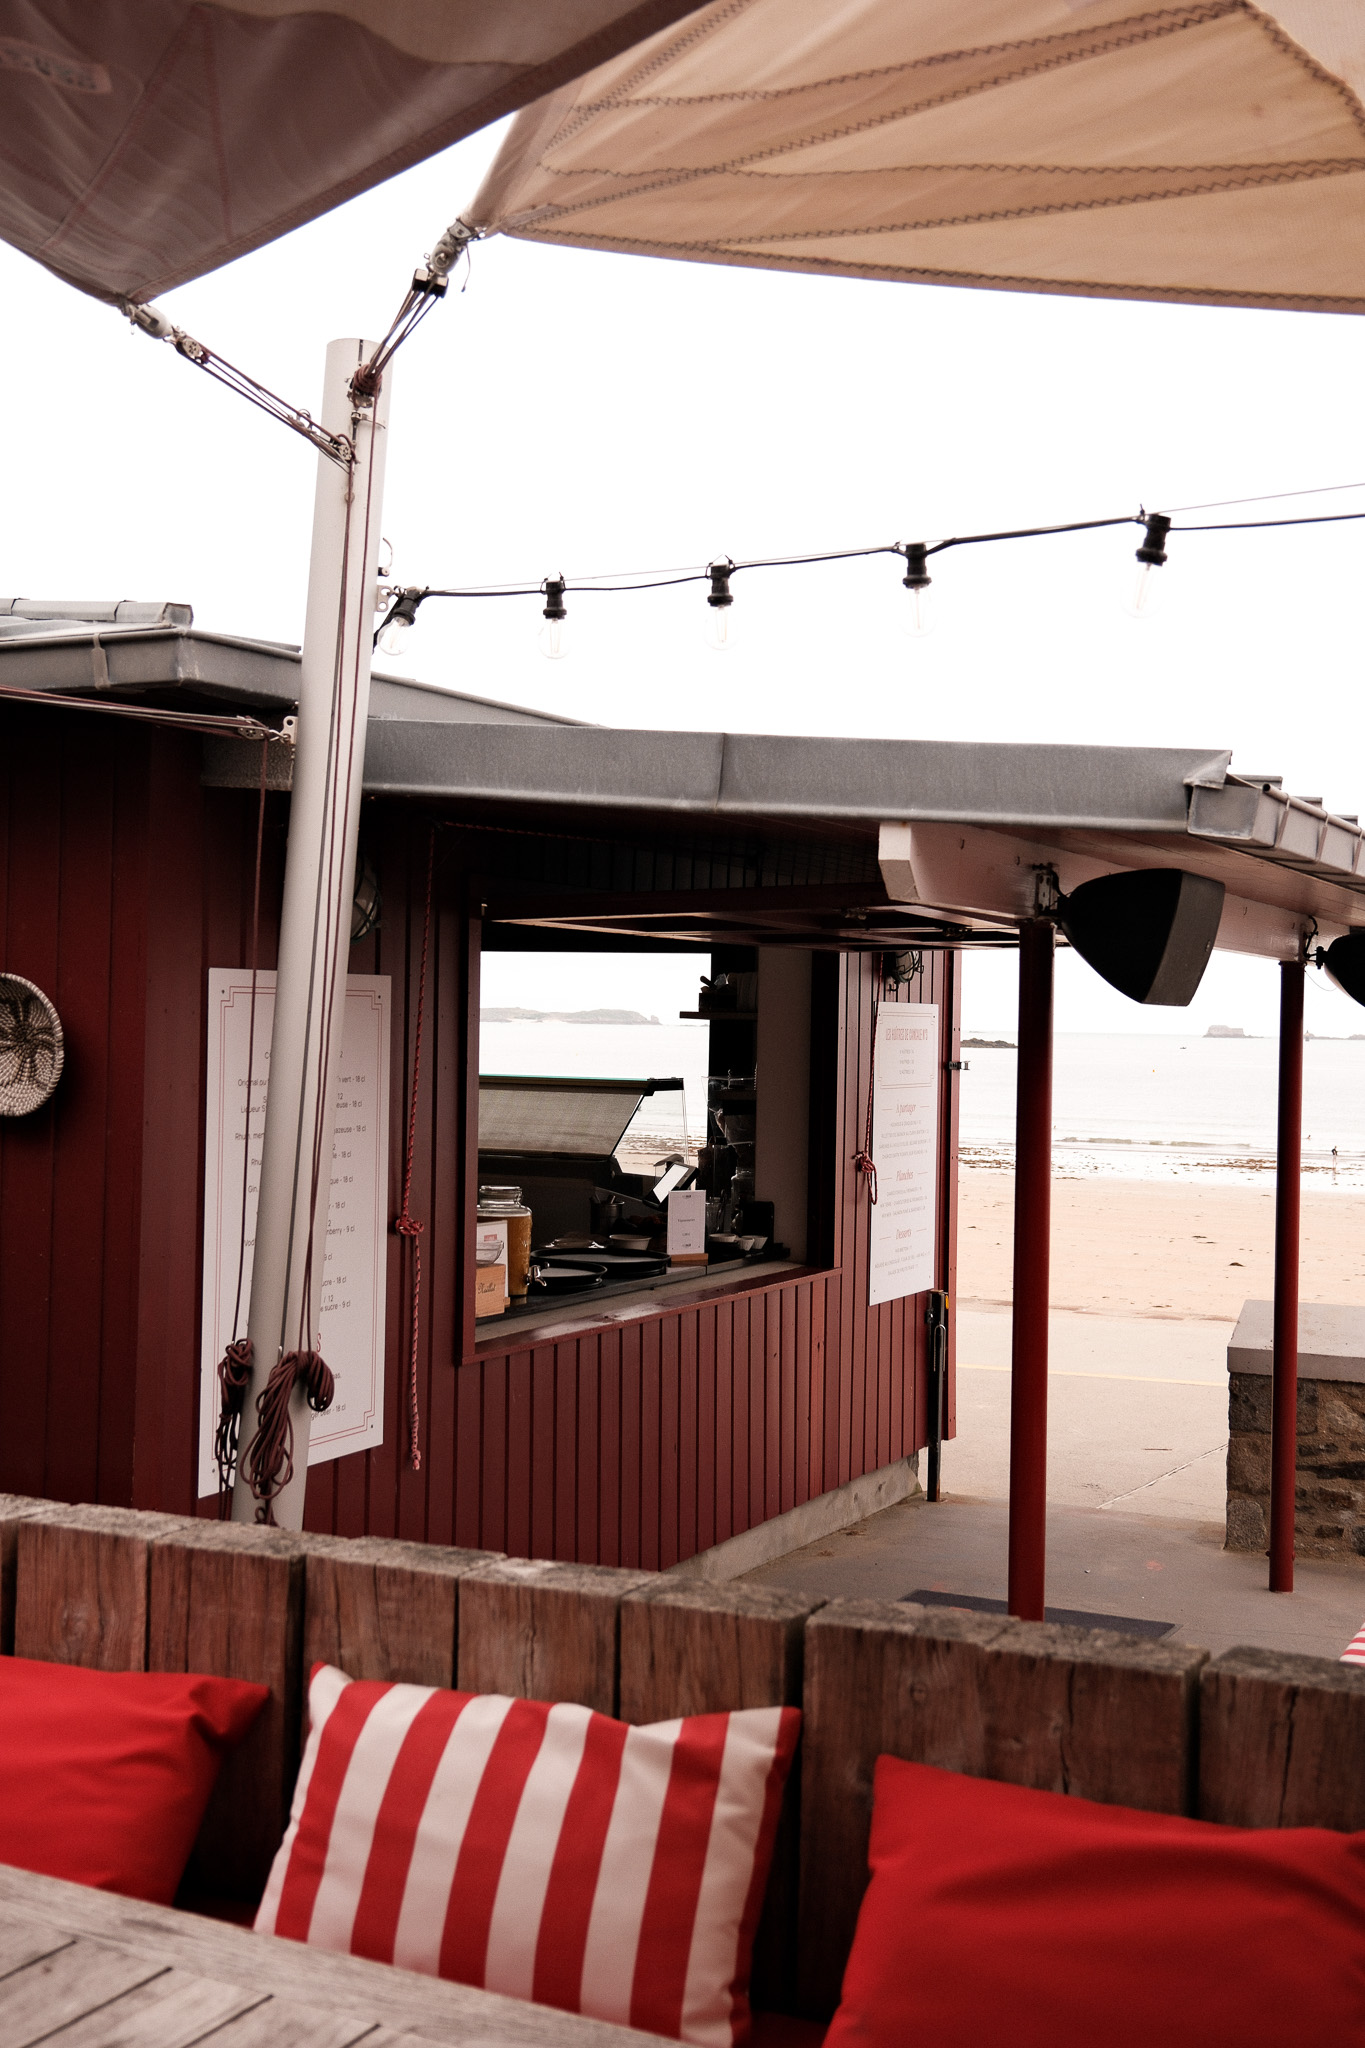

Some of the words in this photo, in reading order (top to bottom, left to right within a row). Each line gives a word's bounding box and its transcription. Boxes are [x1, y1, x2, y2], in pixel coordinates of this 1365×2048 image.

[355, 1075, 361, 1083] 18
[361, 1075, 366, 1083] cl
[352, 1100, 357, 1108] 18
[357, 1100, 363, 1108] cl
[356, 1124, 361, 1132] 18
[361, 1124, 367, 1132] cl
[341, 1150, 347, 1158] 18
[346, 1150, 352, 1158] cl
[896, 1168, 914, 1181] Planches
[342, 1175, 348, 1183] 18
[348, 1175, 354, 1183] cl
[335, 1201, 340, 1210] 18
[340, 1201, 346, 1209] cl
[346, 1225, 350, 1233] 9
[350, 1225, 355, 1233] cl
[895, 1228, 912, 1240] Desserts
[327, 1253, 333, 1261] cl
[336, 1276, 341, 1284] 18
[342, 1276, 347, 1284] cl
[328, 1294, 334, 1302] 12
[324, 1303, 338, 1312] sucre
[345, 1300, 351, 1308] cl
[335, 1404, 341, 1412] 18
[341, 1403, 347, 1411] cl
